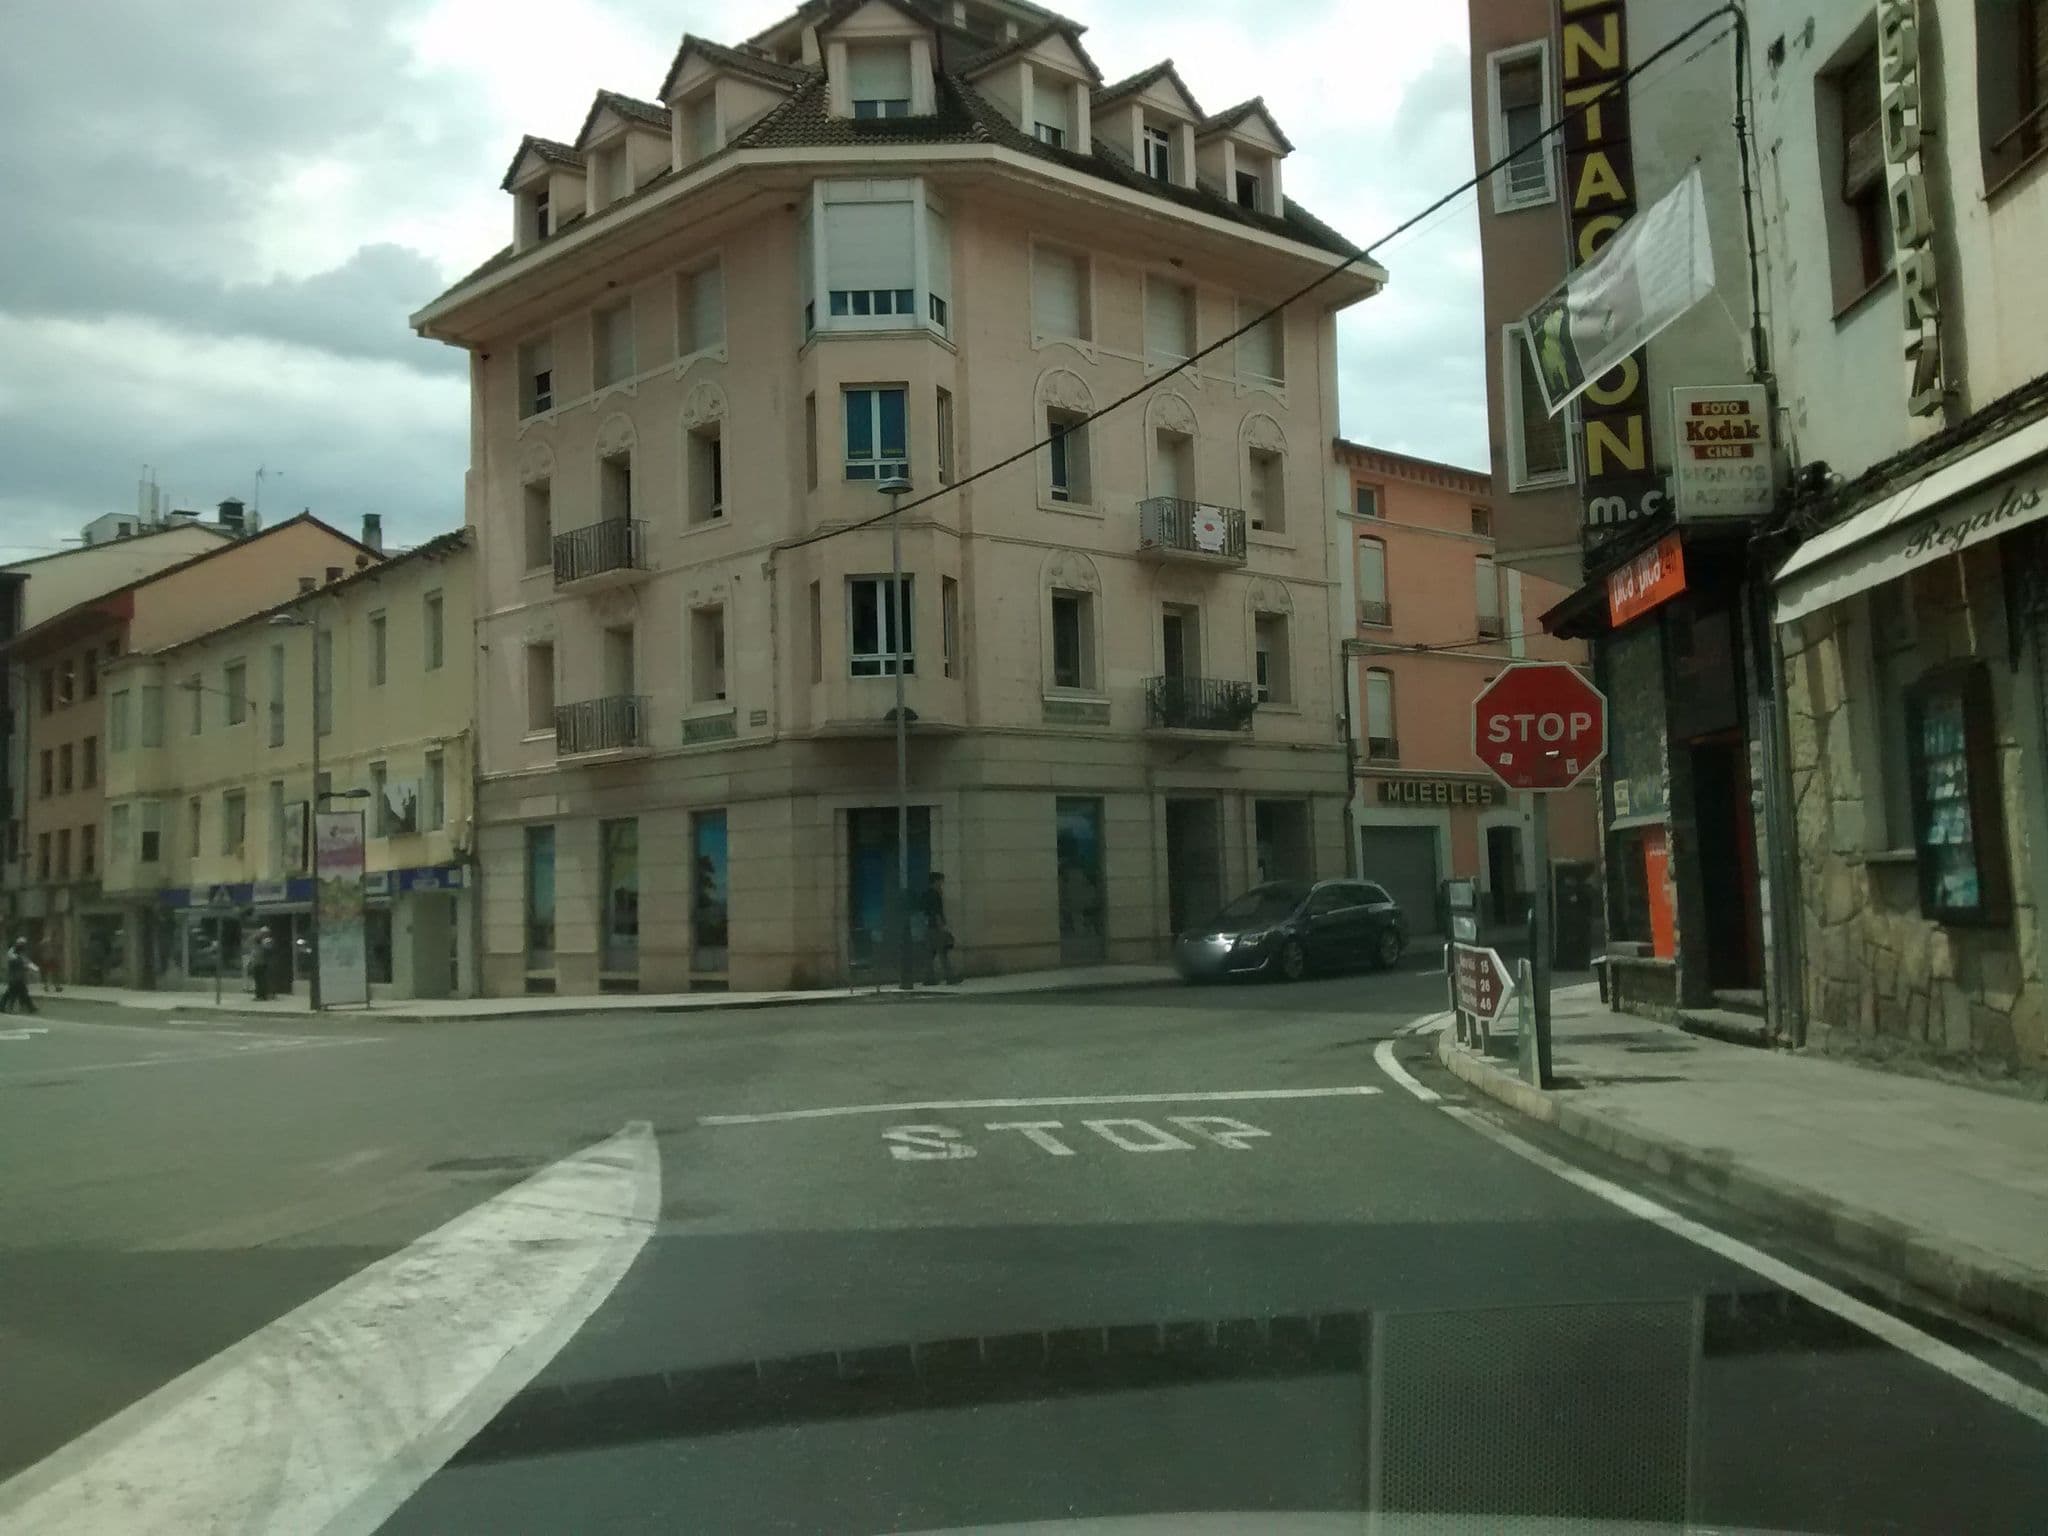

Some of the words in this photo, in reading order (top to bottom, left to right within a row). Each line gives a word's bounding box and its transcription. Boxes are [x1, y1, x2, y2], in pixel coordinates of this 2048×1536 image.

[1701, 401, 1740, 415] FOTO
[1685, 419, 1761, 441] Kodak
[1706, 445, 1742, 458] CINE
[1904, 486, 2042, 559] Regalos
[1487, 711, 1592, 743] STOP
[1387, 782, 1492, 804] MUEBLES
[880, 1115, 1273, 1161] STOP
